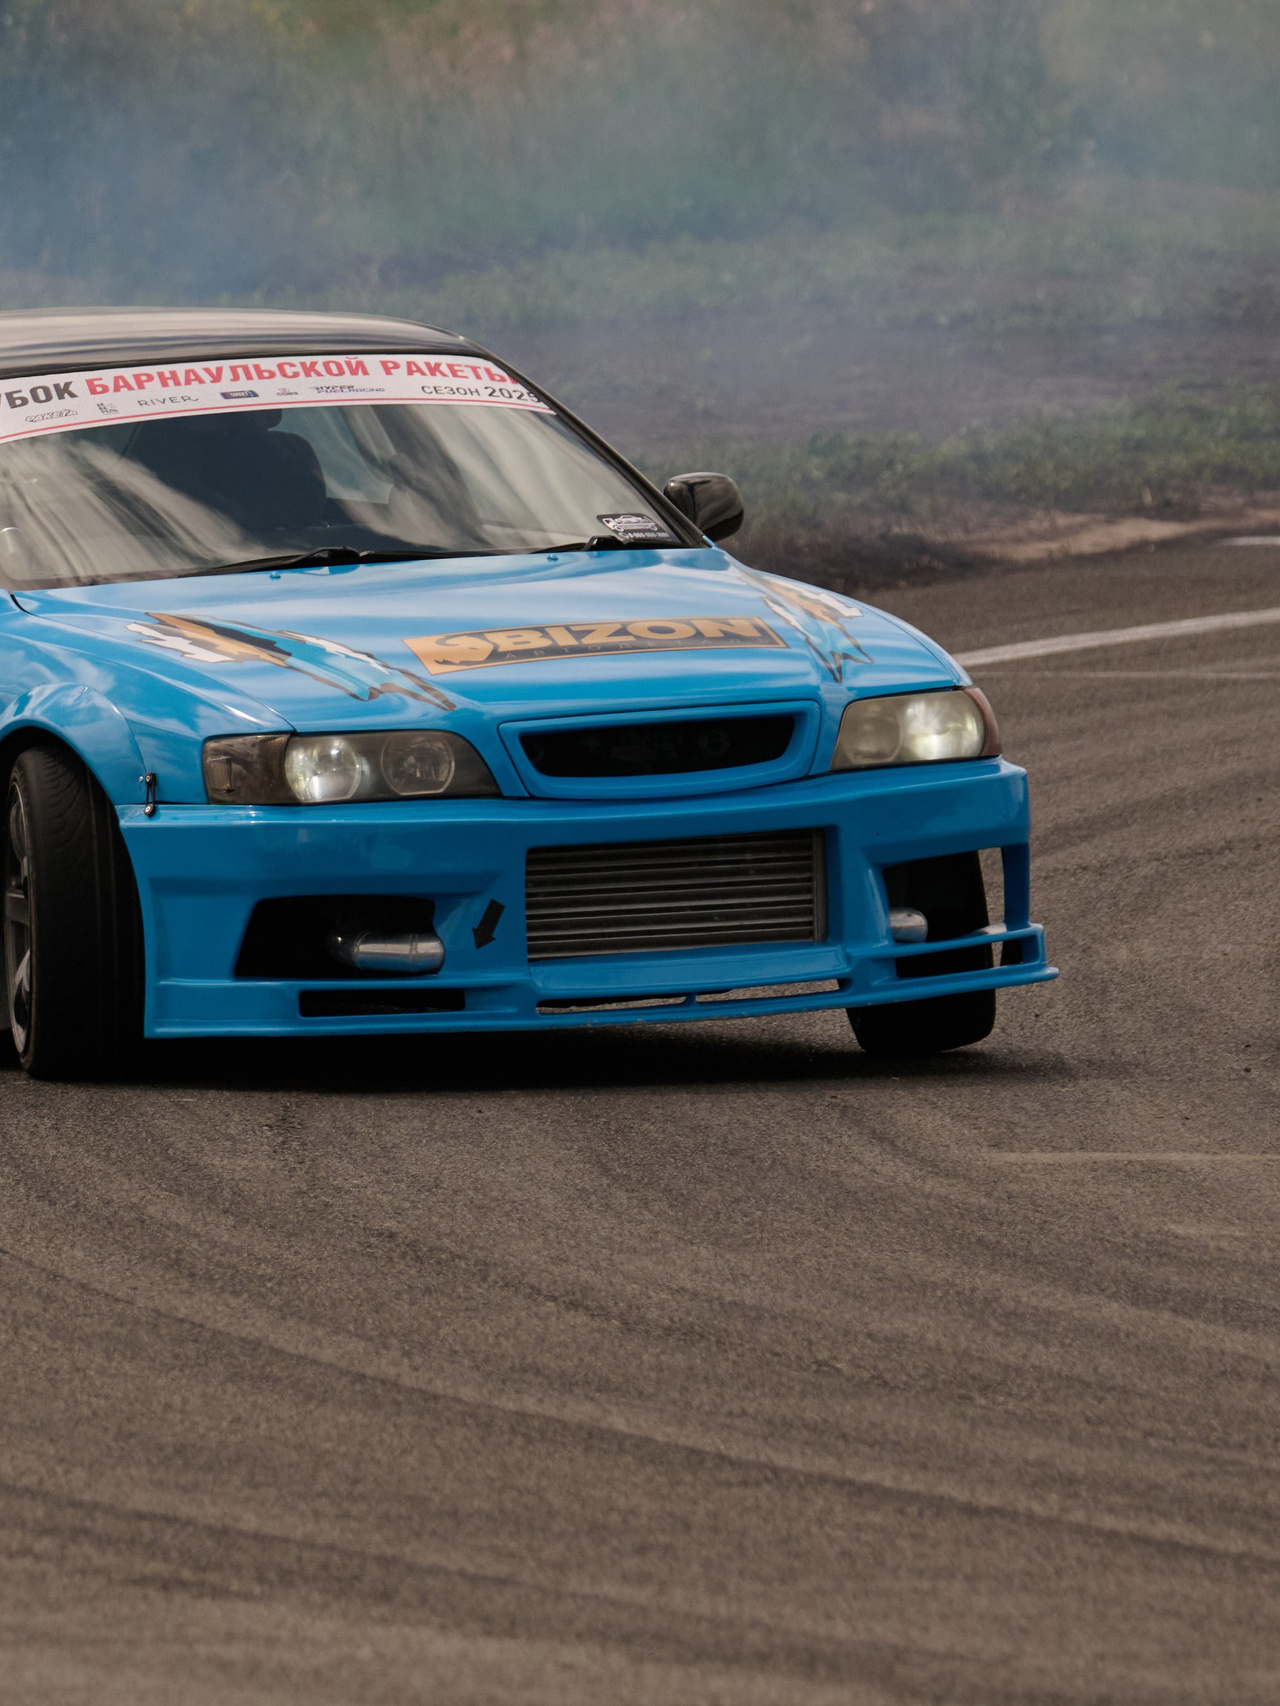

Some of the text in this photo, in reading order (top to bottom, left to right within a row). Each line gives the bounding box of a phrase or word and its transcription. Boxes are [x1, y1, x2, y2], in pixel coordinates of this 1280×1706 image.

[85, 356, 370, 396] БАРНАУЛЬСКОЙ
[137, 395, 199, 407] RIVER
[421, 385, 542, 403] СЕЗОН 2025
[496, 618, 763, 652] BIZON
